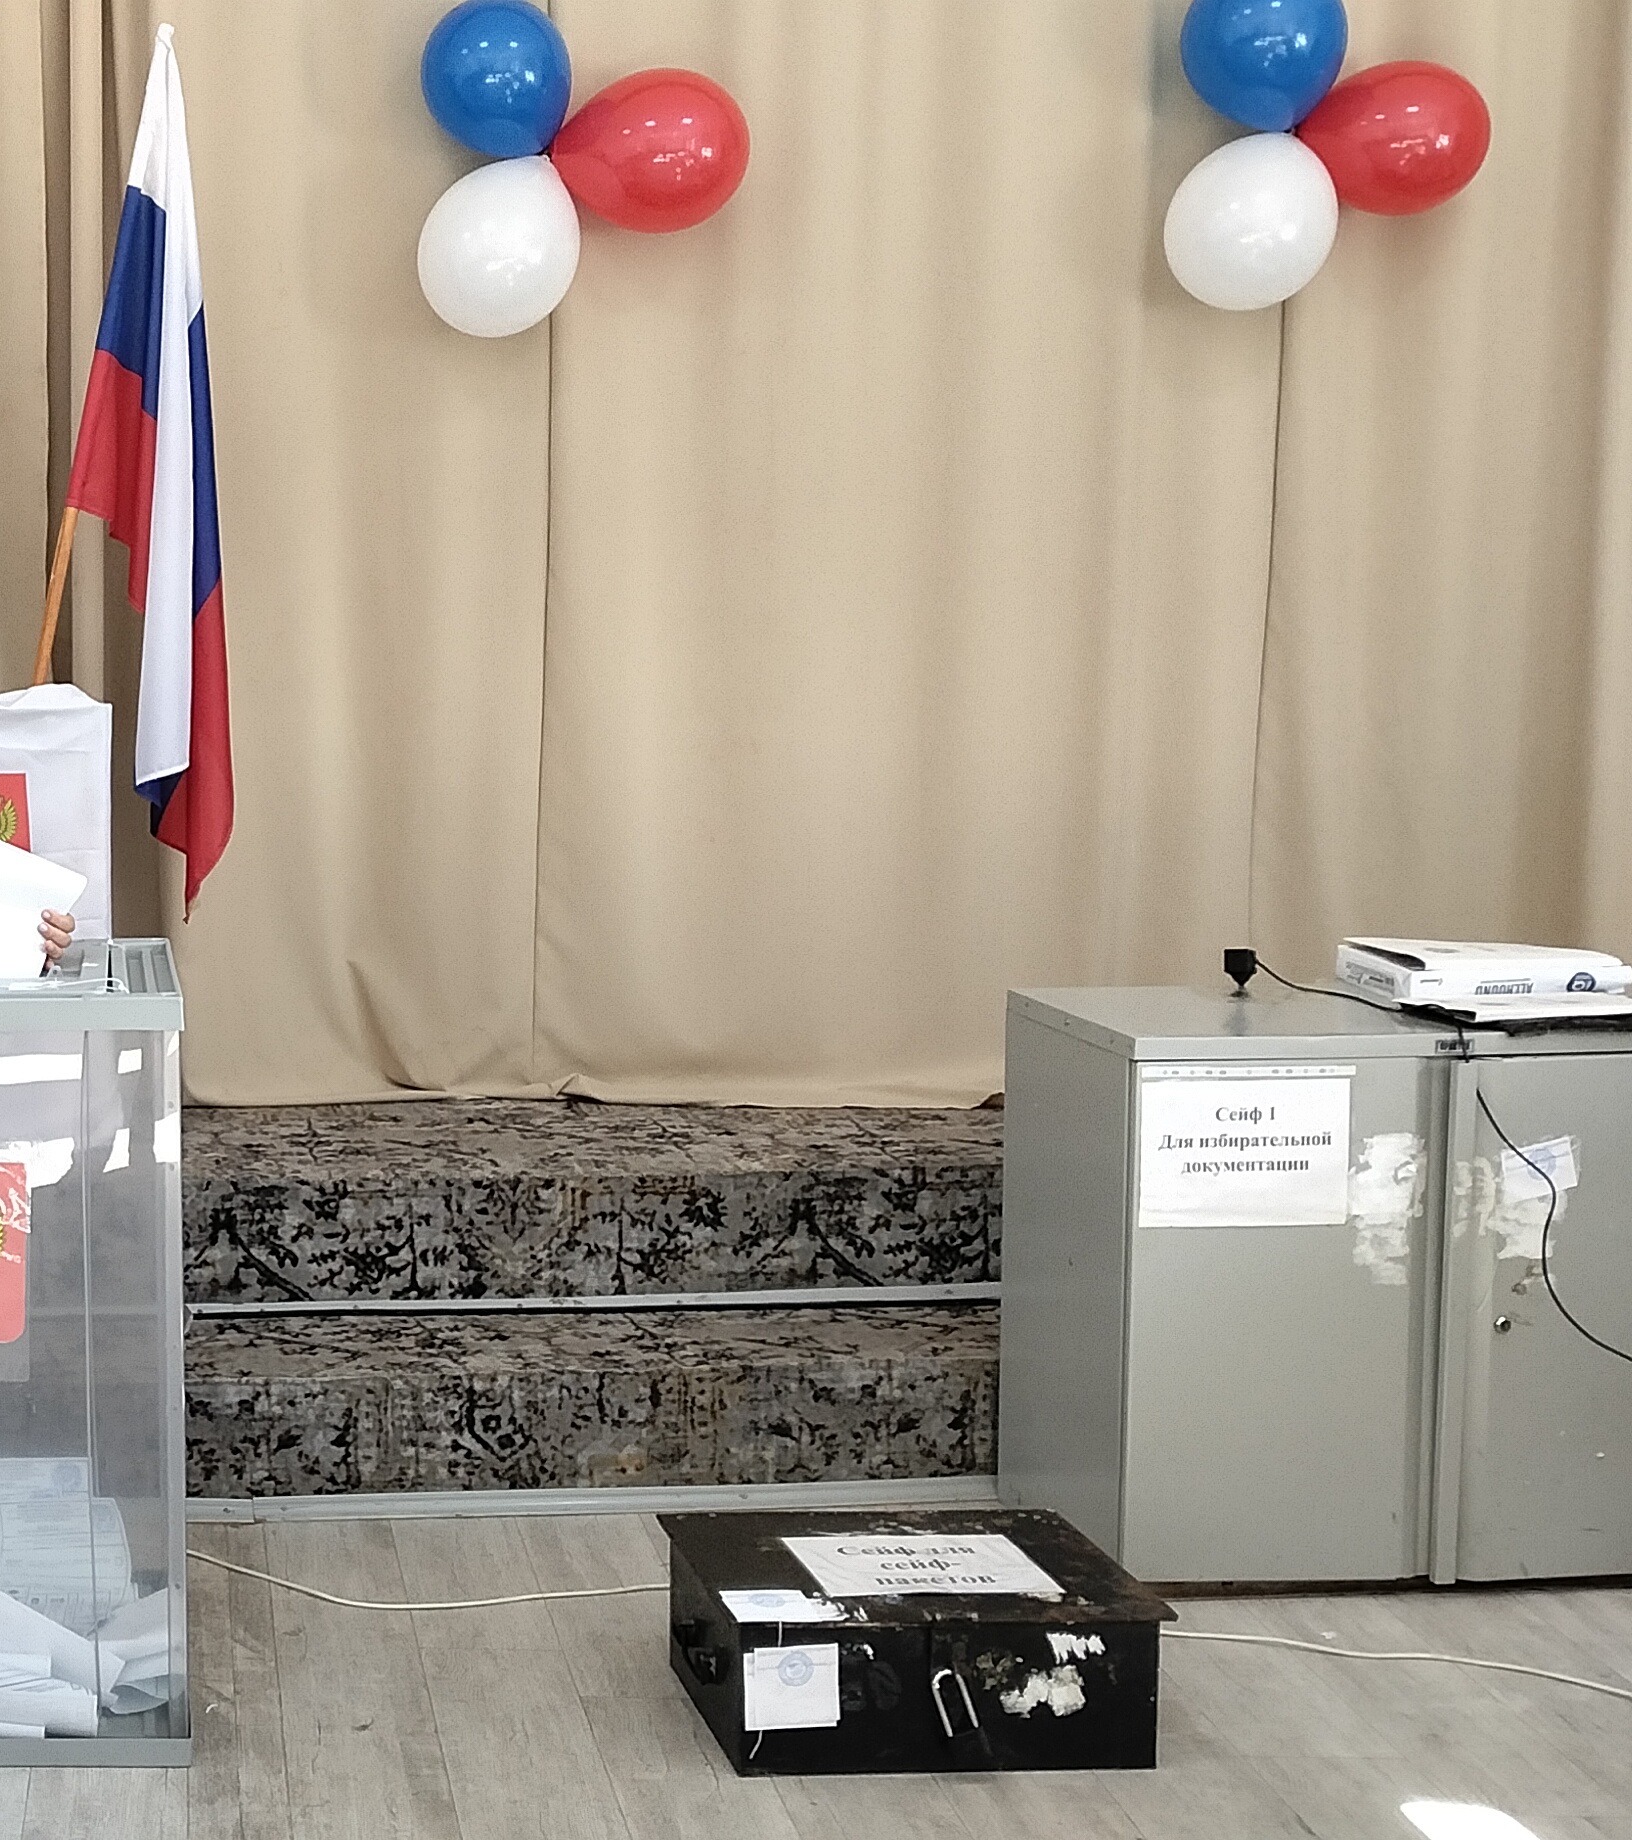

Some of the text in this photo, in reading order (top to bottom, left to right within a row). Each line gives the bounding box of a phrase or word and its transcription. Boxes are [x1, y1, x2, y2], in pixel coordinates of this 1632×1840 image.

[1215, 1106, 1275, 1124] Сейф 1
[1158, 1131, 1332, 1151] Для избирательной
[1181, 1159, 1309, 1177] документации
[836, 1545, 916, 1556] Сейф
[880, 1558, 961, 1571] сейф-
[875, 1573, 996, 1586] пакетов
